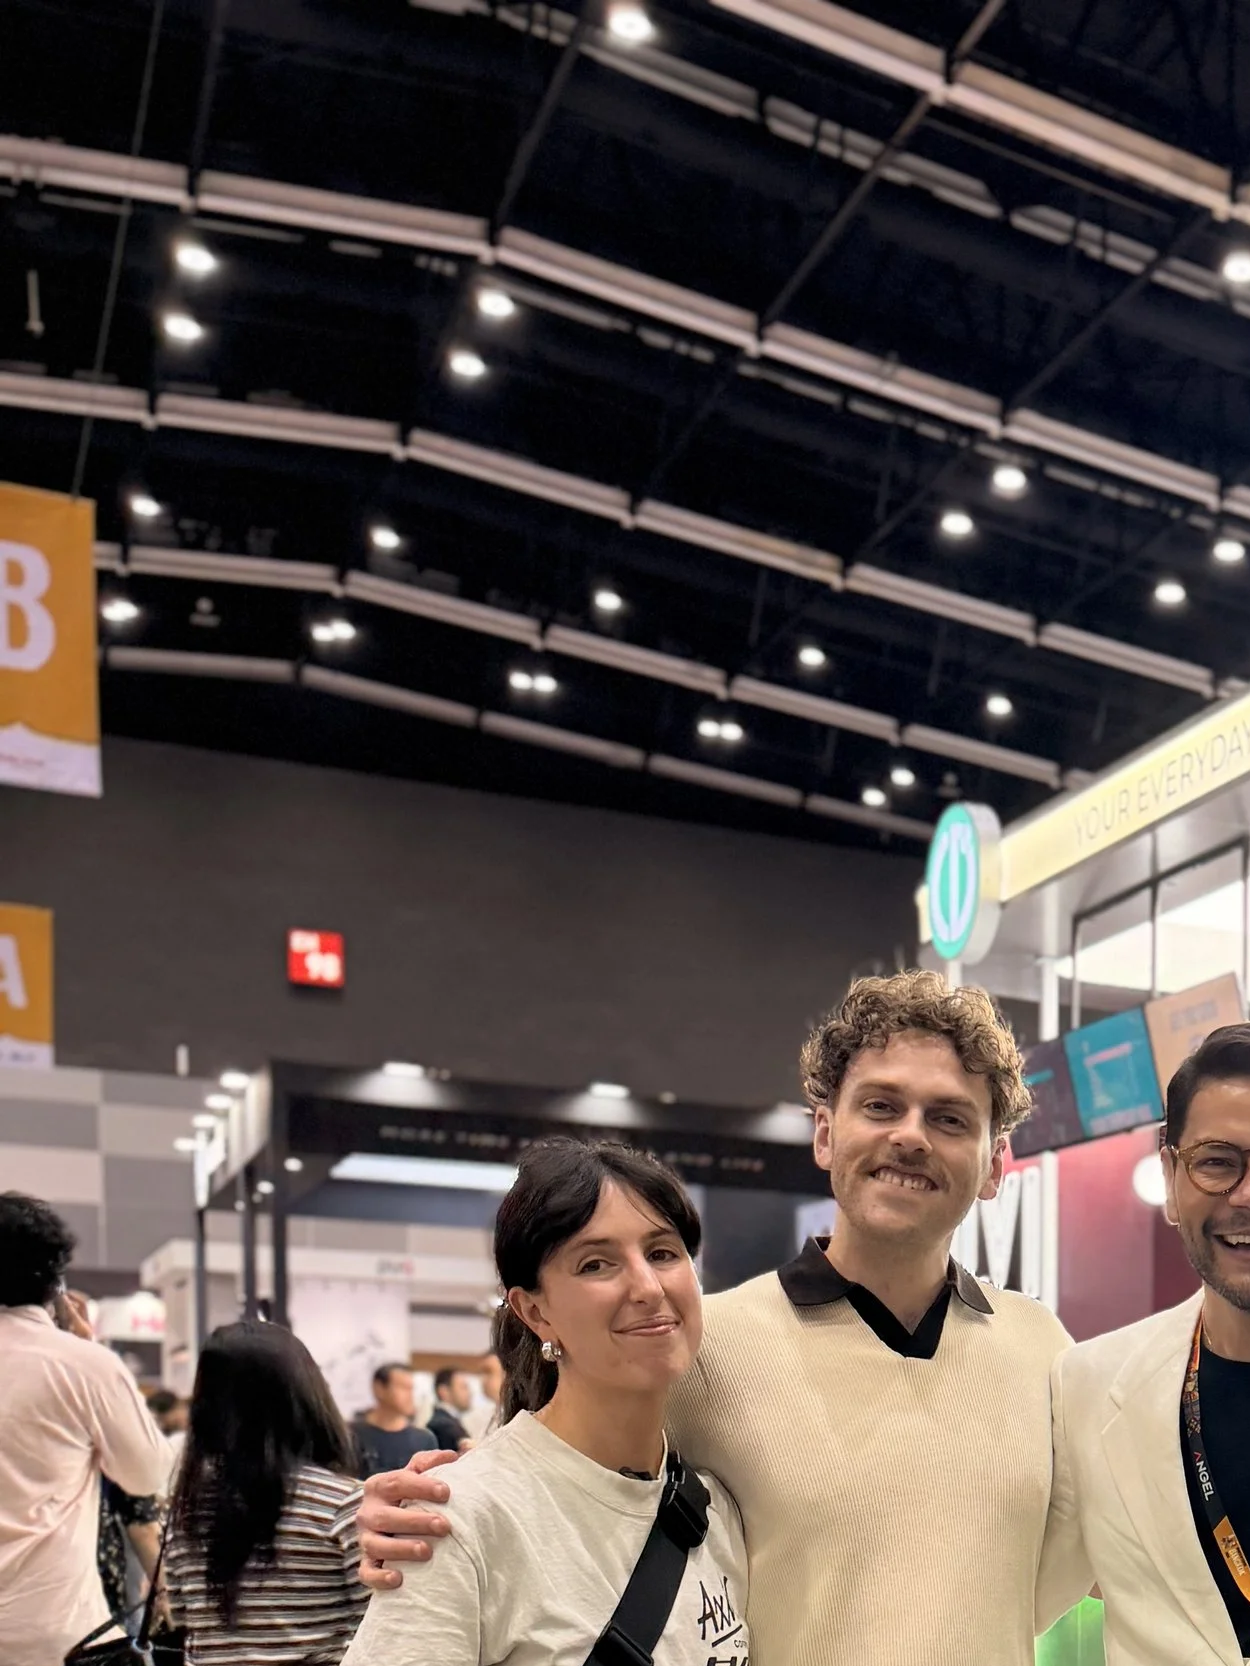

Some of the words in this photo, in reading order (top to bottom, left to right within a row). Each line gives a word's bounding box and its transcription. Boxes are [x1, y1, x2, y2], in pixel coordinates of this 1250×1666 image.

[0, 538, 57, 672] B
[1073, 788, 1131, 847] YOUR
[1193, 1451, 1215, 1502] ANGEL
